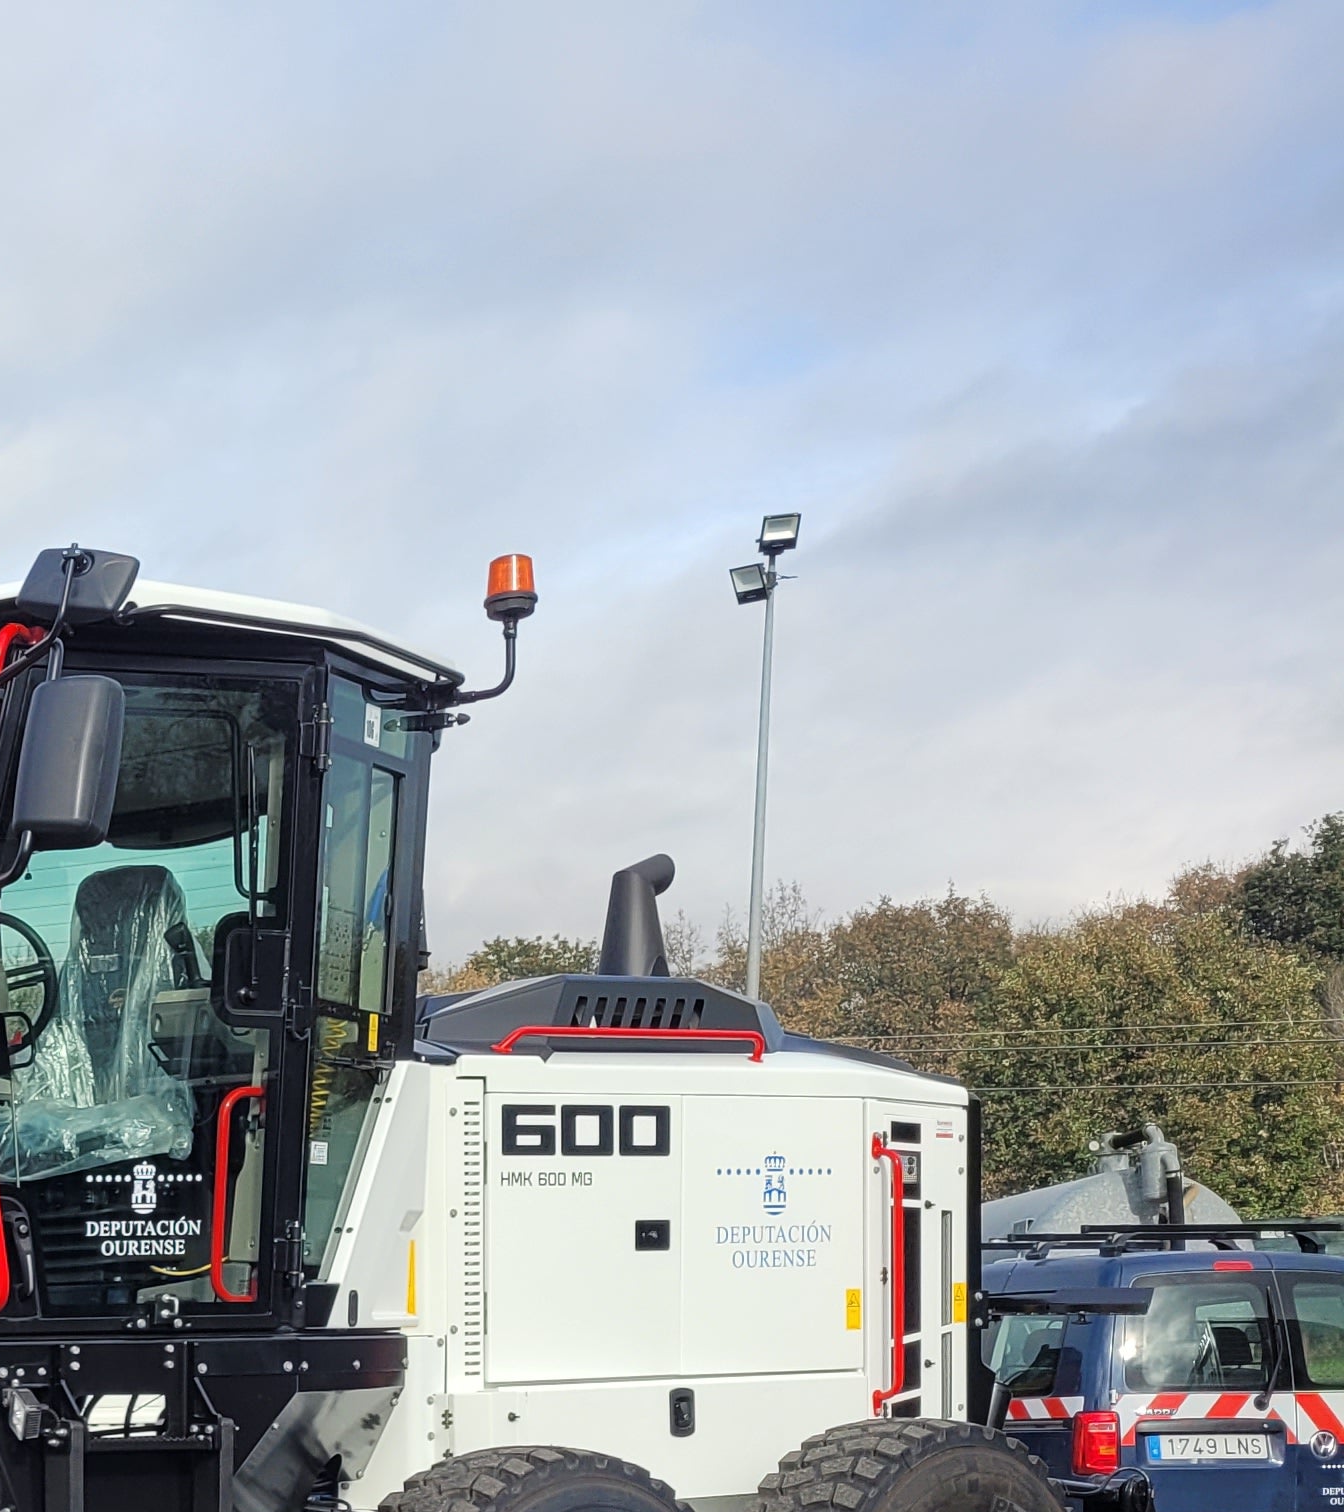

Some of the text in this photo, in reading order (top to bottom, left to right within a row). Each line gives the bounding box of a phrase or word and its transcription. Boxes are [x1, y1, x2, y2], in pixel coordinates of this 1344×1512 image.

[501, 1103, 671, 1157] 600
[500, 1171, 594, 1187] HMK 600 MG
[84, 1215, 203, 1238] DEPUTACIÓN
[715, 1219, 833, 1245] DEPUTACIÓN
[100, 1239, 187, 1257] OURENSE
[731, 1248, 818, 1269] OURENSE
[1167, 1437, 1263, 1456] 1749 LNS
